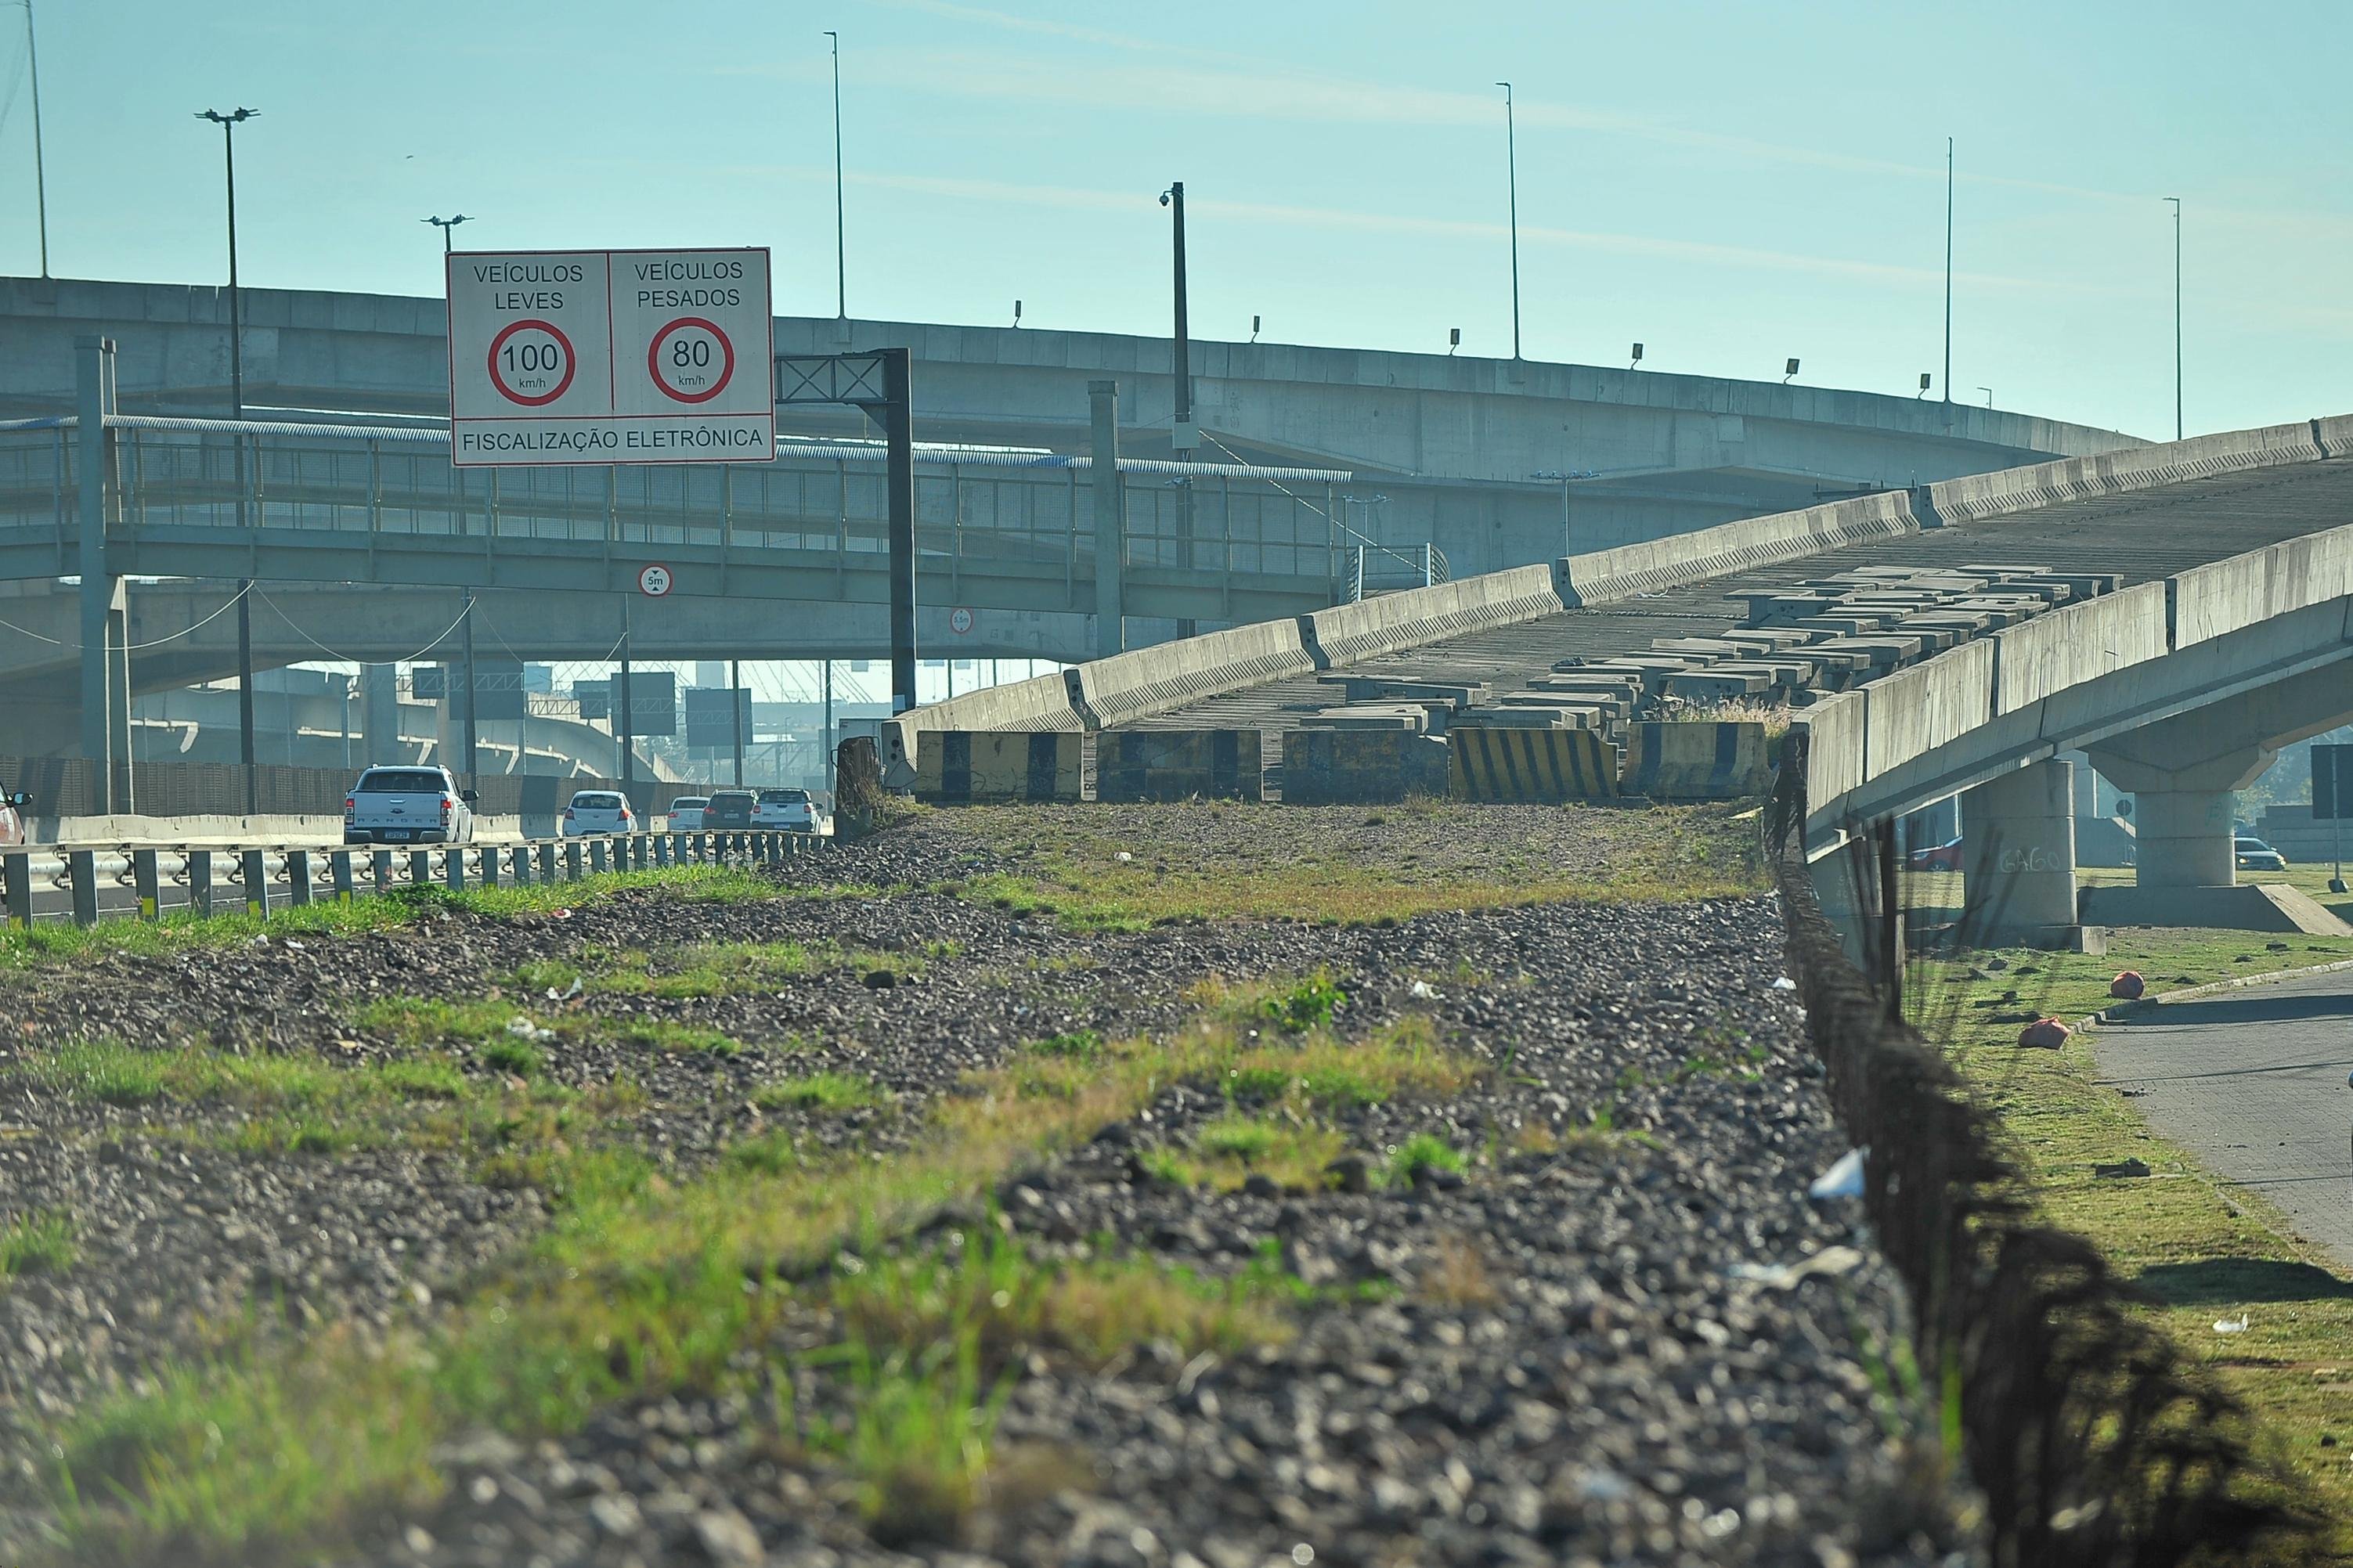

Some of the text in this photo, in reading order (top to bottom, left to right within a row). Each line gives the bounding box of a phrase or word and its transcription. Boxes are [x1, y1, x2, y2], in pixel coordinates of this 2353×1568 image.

[473, 261, 583, 283] VEÍCULOS
[633, 259, 743, 281] VEÍCULOS
[495, 291, 564, 310] LEVES
[637, 288, 741, 308] PESADOS
[503, 344, 558, 373] 100
[673, 339, 710, 368] 80
[518, 377, 547, 389] km/h
[678, 375, 706, 387] km/h
[463, 426, 763, 452] FISCALIZAÇÃO ELETRÔNICA
[648, 576, 663, 586] 5m
